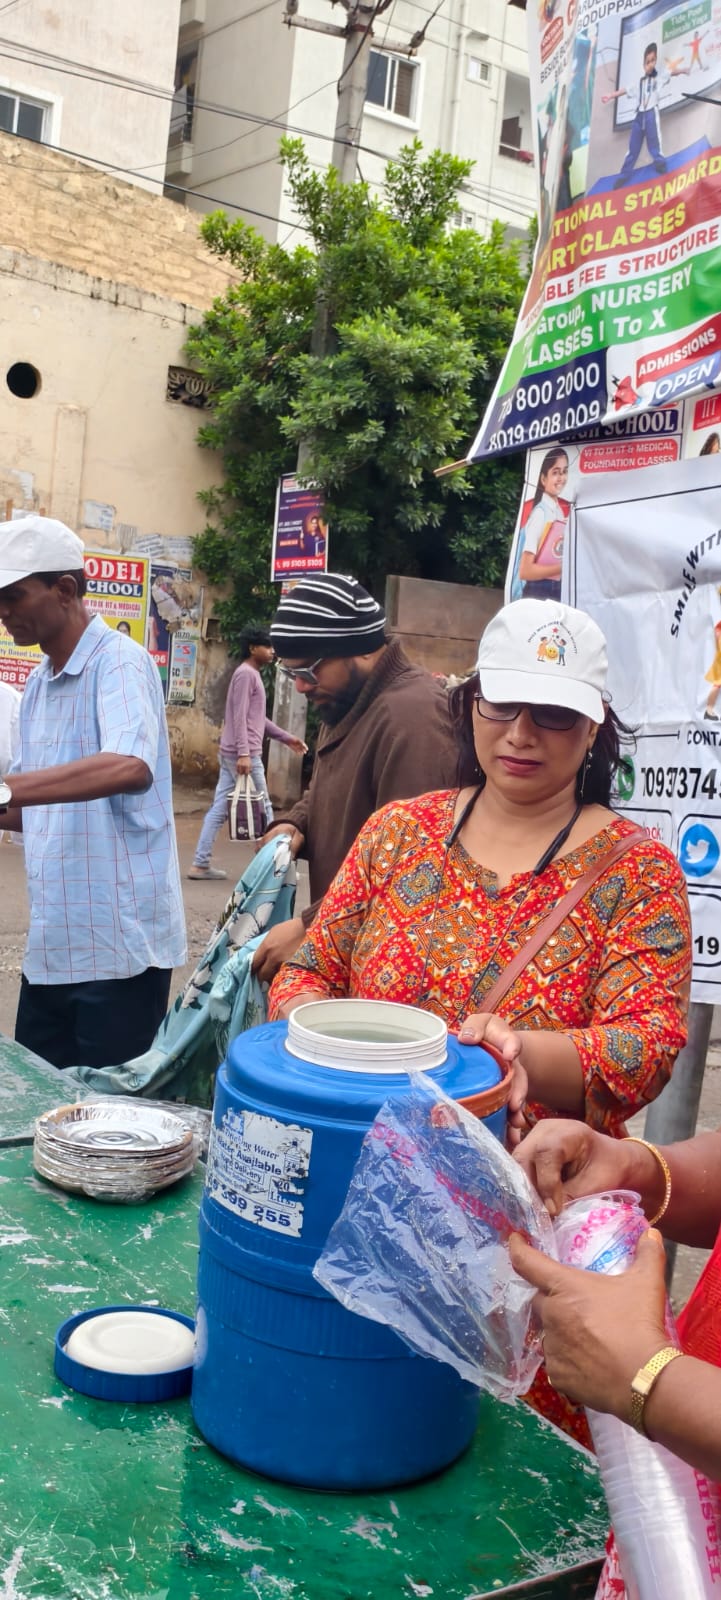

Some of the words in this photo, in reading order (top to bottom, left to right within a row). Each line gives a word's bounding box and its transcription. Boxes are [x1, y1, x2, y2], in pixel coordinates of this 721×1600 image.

[551, 199, 617, 240] TIONAL
[624, 155, 721, 212] STANDARD
[580, 202, 686, 256] CLASSES
[546, 279, 575, 301] BLE
[579, 264, 607, 288] FEE
[618, 225, 720, 276] STRUCTURE
[591, 263, 693, 313] NURSERY
[526, 326, 593, 369] LASSES
[612, 316, 642, 338] To
[648, 306, 668, 331] X
[638, 328, 717, 377] ADMISSIONS
[516, 381, 552, 411] 800
[556, 362, 600, 400] 2000
[655, 358, 715, 400] OPEN
[605, 410, 674, 436] SCHOOL
[636, 442, 674, 452] MEDICAL
[84, 558, 141, 582] ODEL
[86, 580, 142, 597] CHOOL
[670, 568, 697, 638] SMILE
[0, 671, 16, 681] 88
[694, 935, 720, 955] 19
[236, 1150, 282, 1175] Available
[254, 1143, 280, 1160] Water
[253, 1204, 291, 1228] 255
